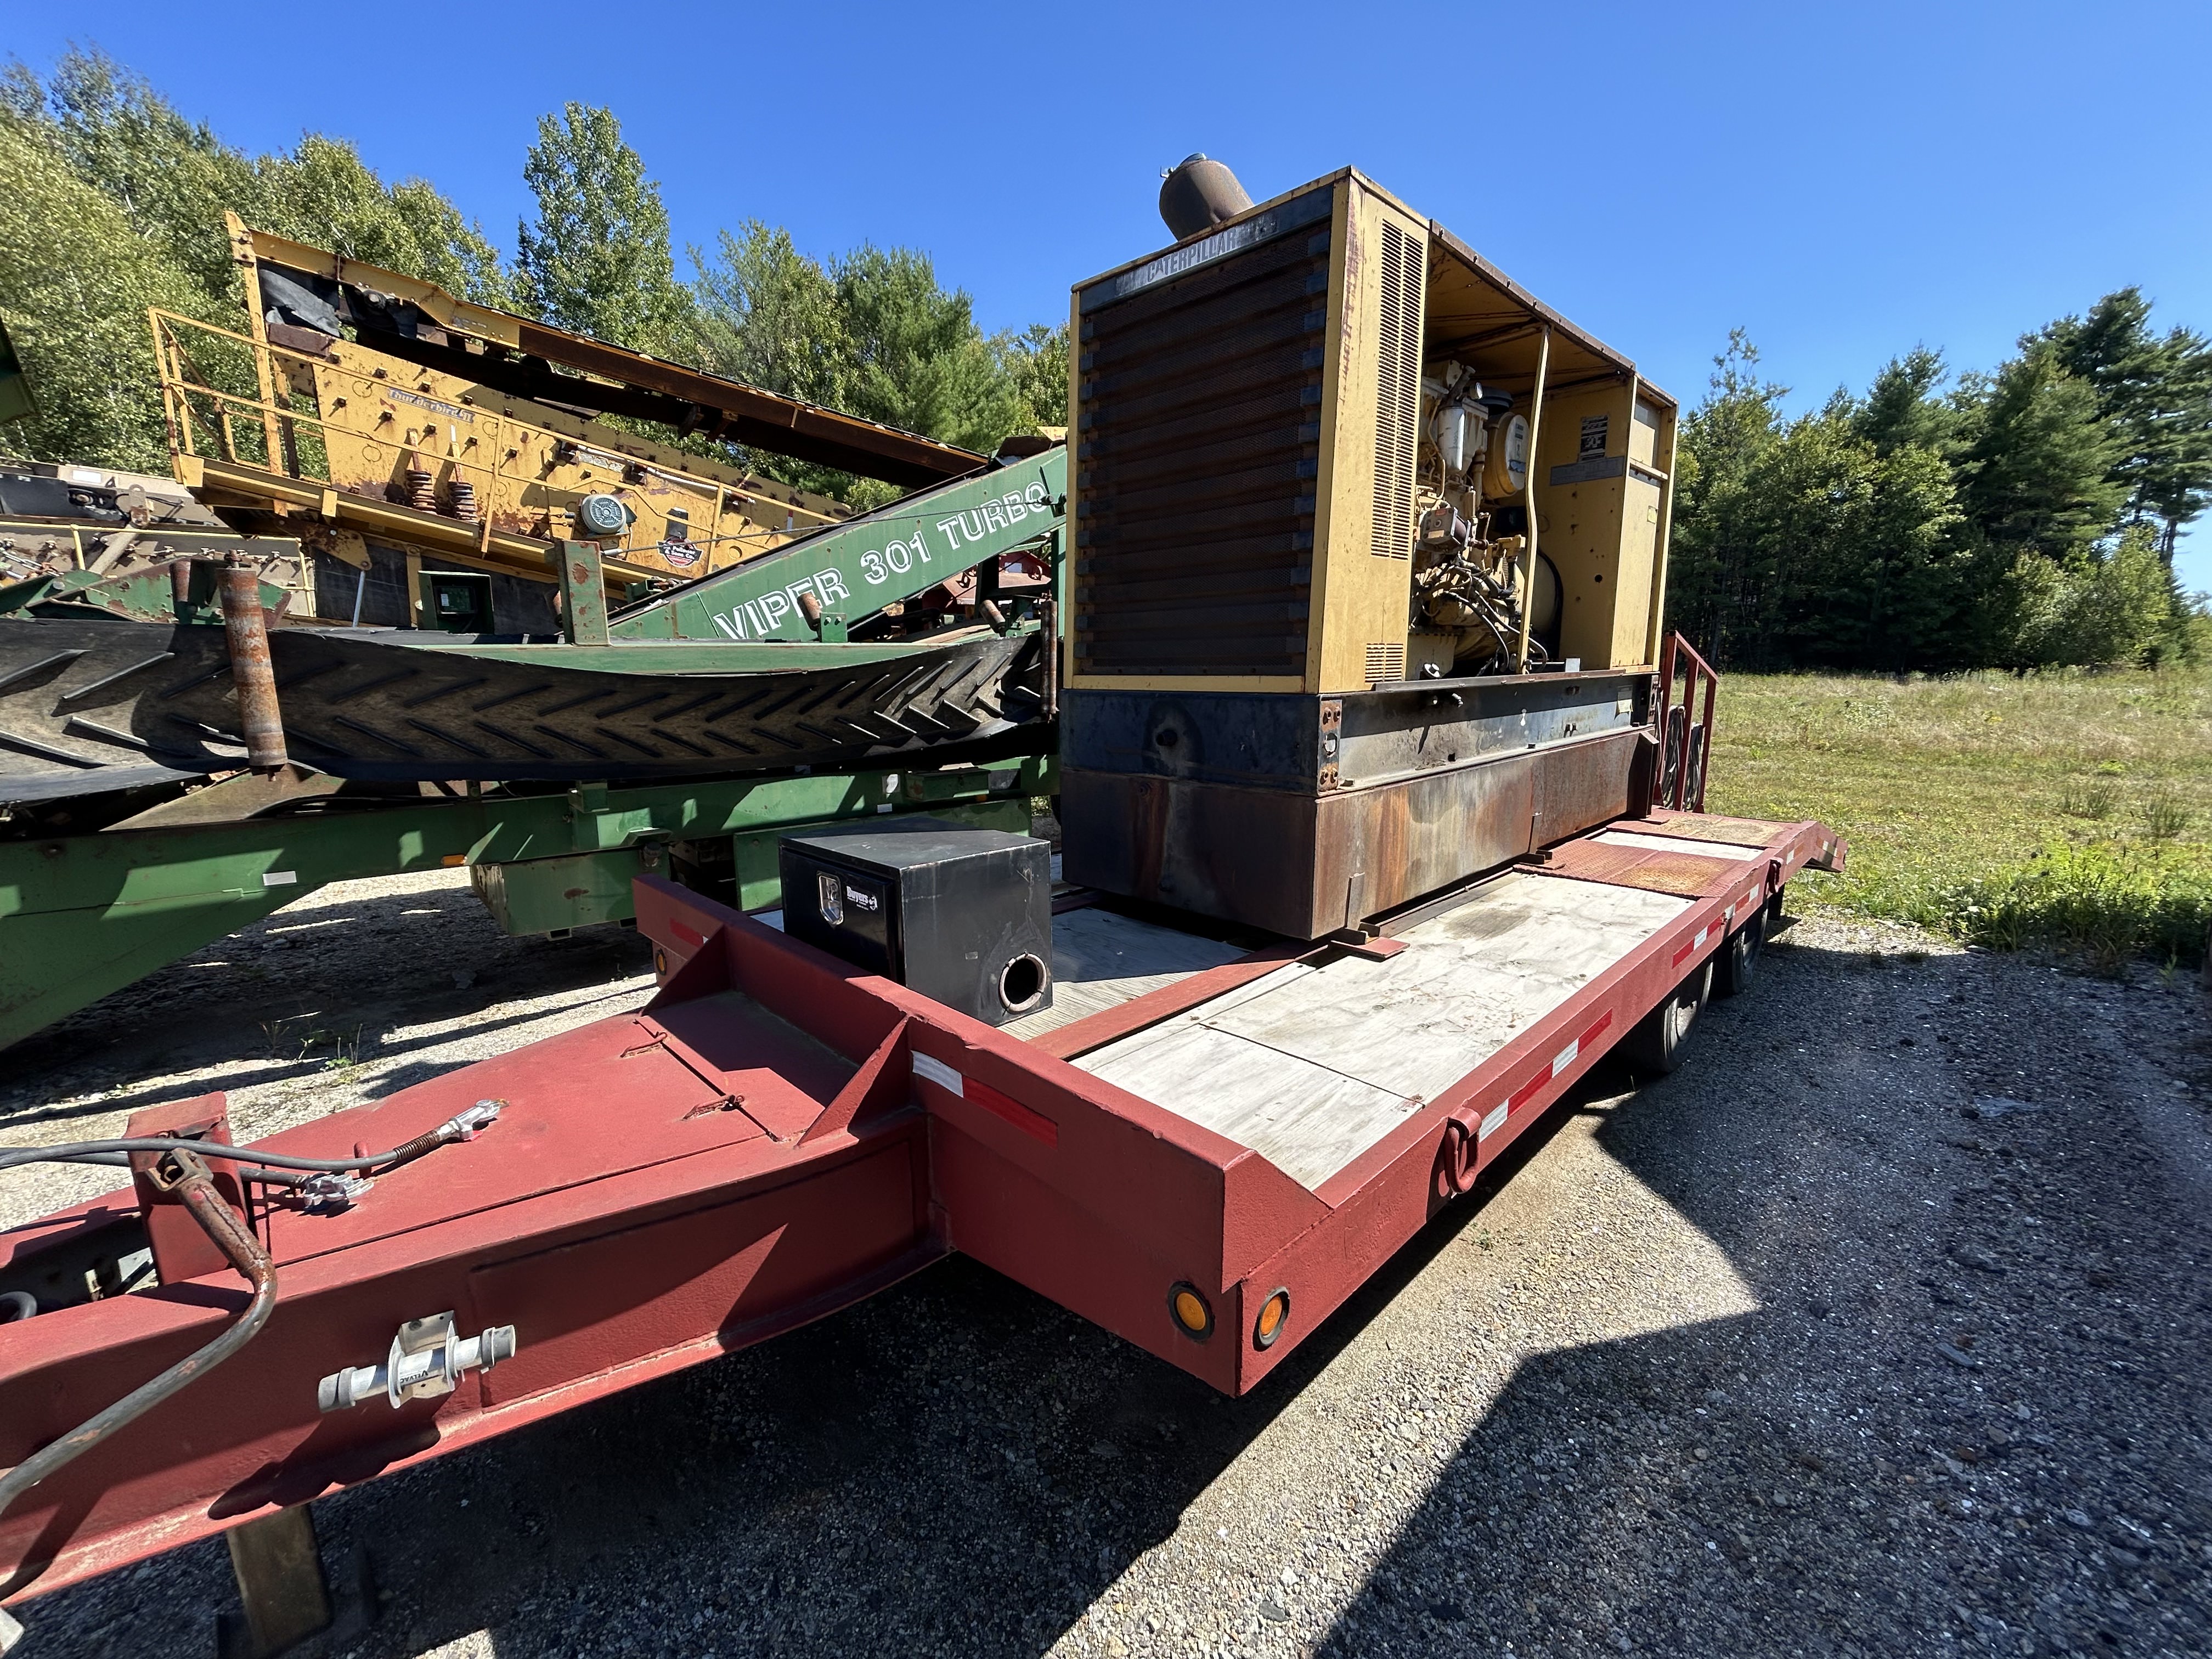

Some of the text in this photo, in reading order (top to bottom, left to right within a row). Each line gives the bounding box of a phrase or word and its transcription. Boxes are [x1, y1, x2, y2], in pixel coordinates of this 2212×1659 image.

[1147, 229, 1237, 283] CATERPILLAR
[714, 481, 1047, 640] VIPER 301 TURBO
[847, 885, 868, 904] Buyers
[399, 1370, 428, 1383] VELVAC
